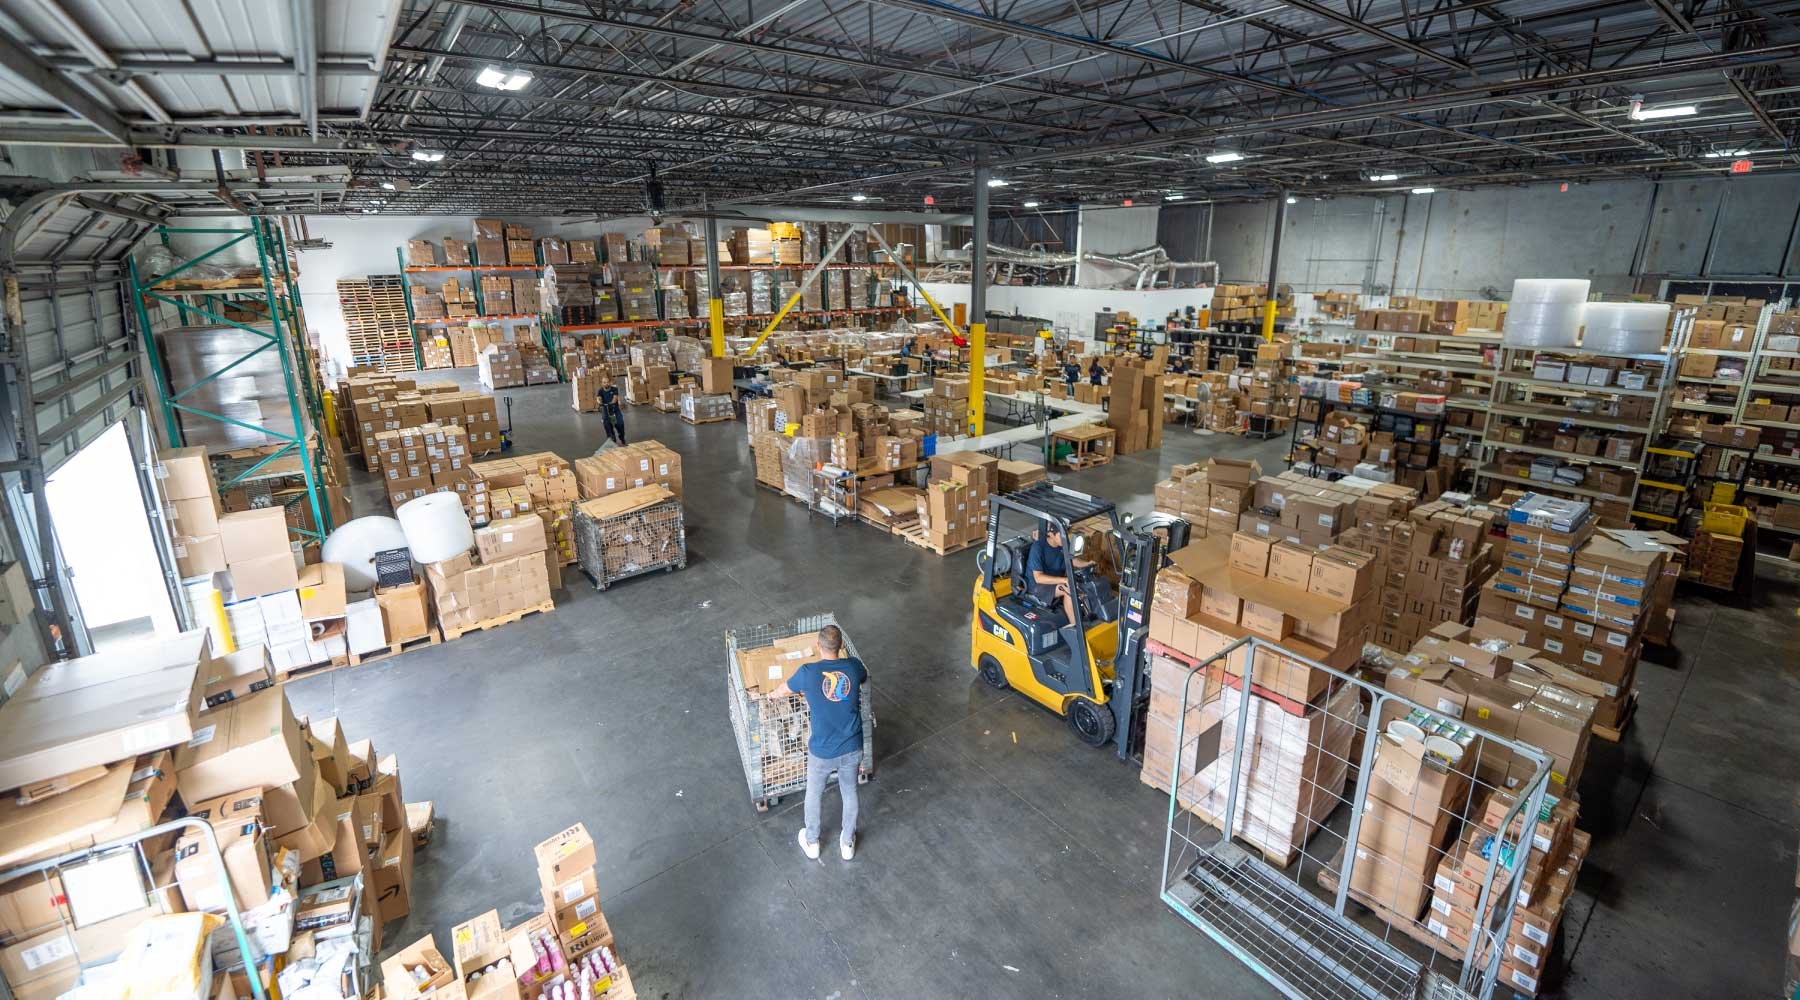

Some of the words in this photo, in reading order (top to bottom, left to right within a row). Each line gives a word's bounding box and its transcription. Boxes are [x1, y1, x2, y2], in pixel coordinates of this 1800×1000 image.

[1130, 597, 1143, 610] CAT
[993, 624, 1009, 641] CAT
[569, 939, 590, 954] Rit
